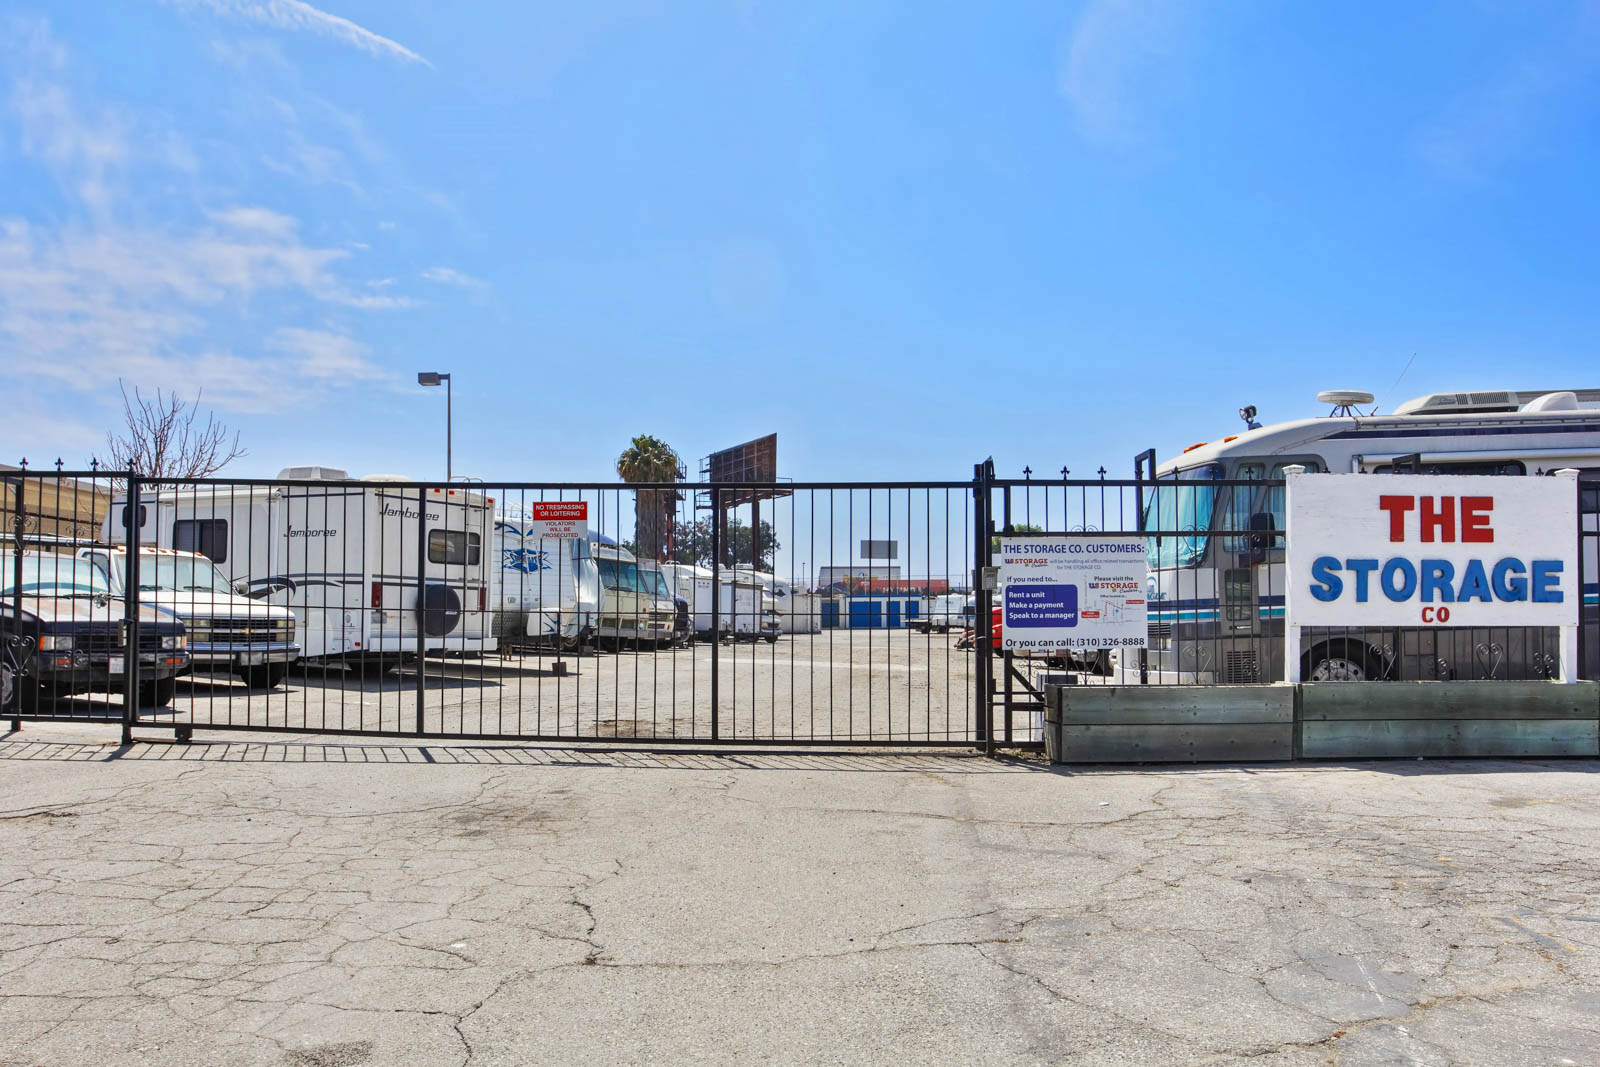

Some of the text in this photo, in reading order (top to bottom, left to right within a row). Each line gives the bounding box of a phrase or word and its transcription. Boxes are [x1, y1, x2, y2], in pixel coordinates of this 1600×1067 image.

[379, 502, 440, 521] Jamboee
[1379, 495, 1494, 543] THE
[283, 525, 337, 538] Jamboree
[1003, 543, 1145, 554] THE STORAGE CO. CUSTOMERS:
[1310, 556, 1564, 603] STORAGE
[1008, 612, 1031, 620] Speak
[1421, 607, 1450, 622] CO
[1005, 639, 1018, 647] Or
[1019, 640, 1036, 648] you
[1056, 638, 1075, 647] call:
[1076, 638, 1100, 647] (310)
[1102, 638, 1145, 646] 326-8888
